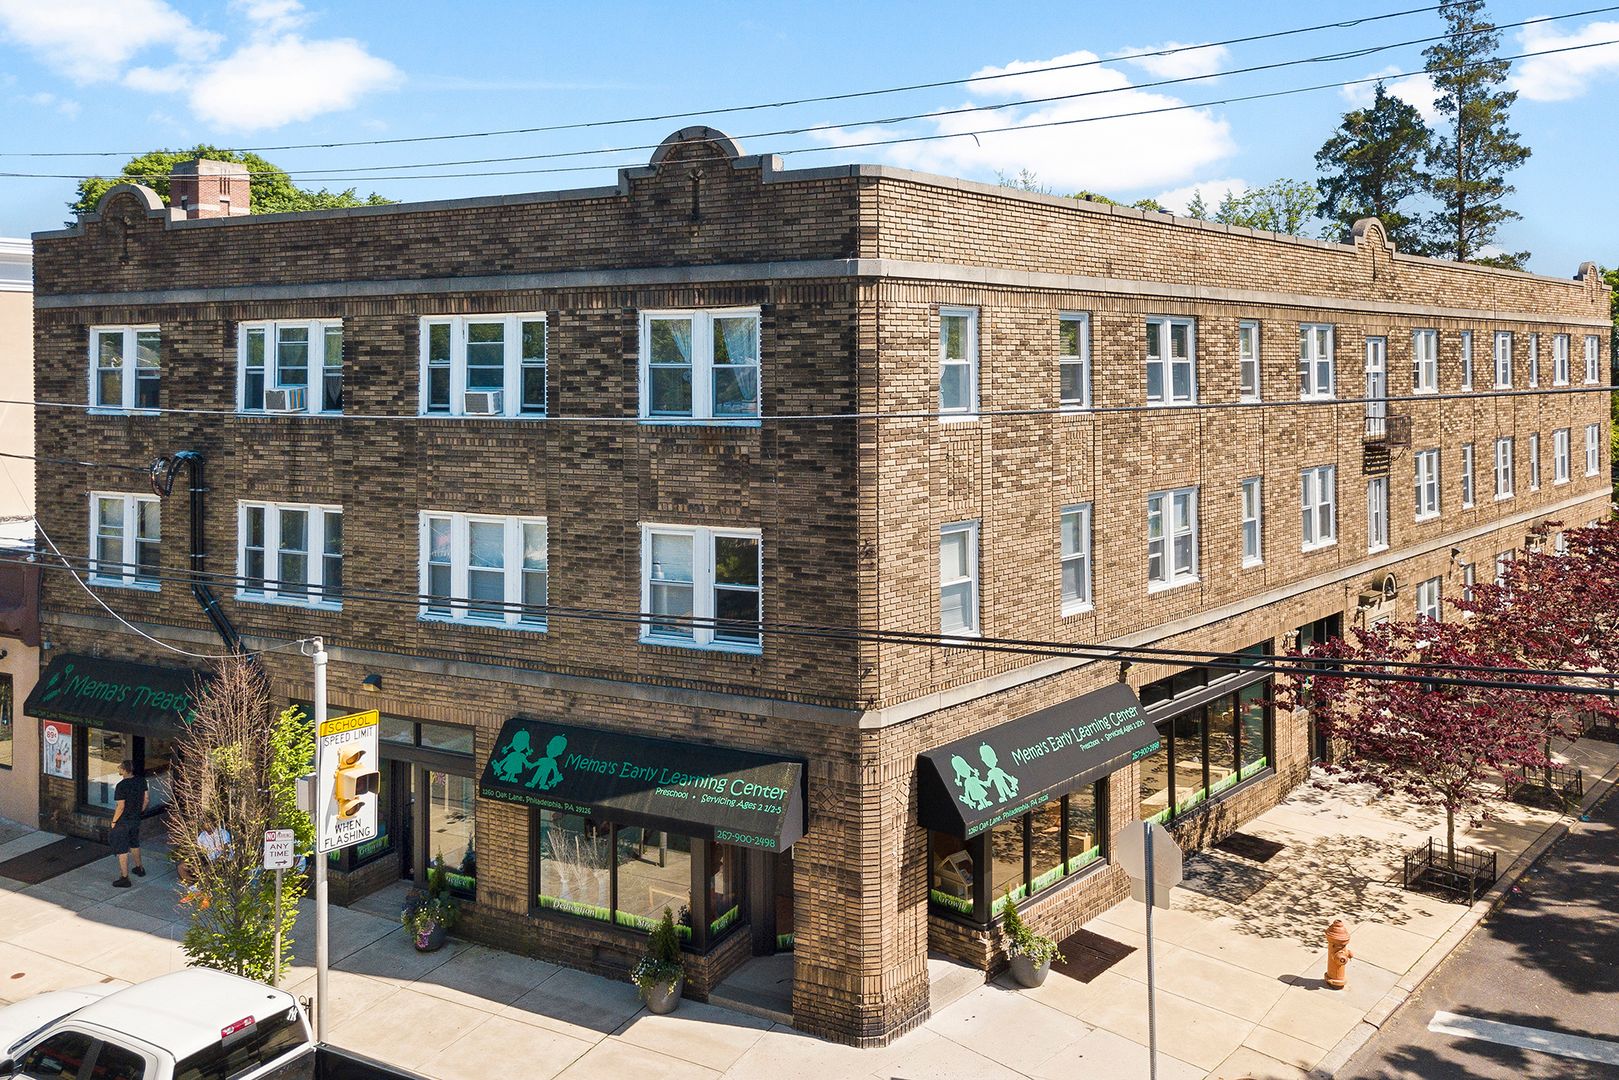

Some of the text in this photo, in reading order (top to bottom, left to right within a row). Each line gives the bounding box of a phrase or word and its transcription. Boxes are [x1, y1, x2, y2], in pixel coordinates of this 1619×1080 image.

[64, 675, 190, 712] Mema's Treats
[328, 716, 370, 733] SCHOOL
[324, 727, 373, 747] SPEED LIMIT
[1011, 706, 1139, 767] Mema's Early Learning Center
[564, 753, 788, 800] Mema's Early Learning Center
[495, 790, 508, 799] Oak
[564, 803, 575, 812] PA
[655, 787, 782, 815] Preschool Servicing Ages 2 1/2-5
[266, 832, 276, 841] NO
[324, 826, 371, 848] FLASHING
[335, 818, 362, 834] WHEN
[716, 830, 776, 848] 267-900-2498
